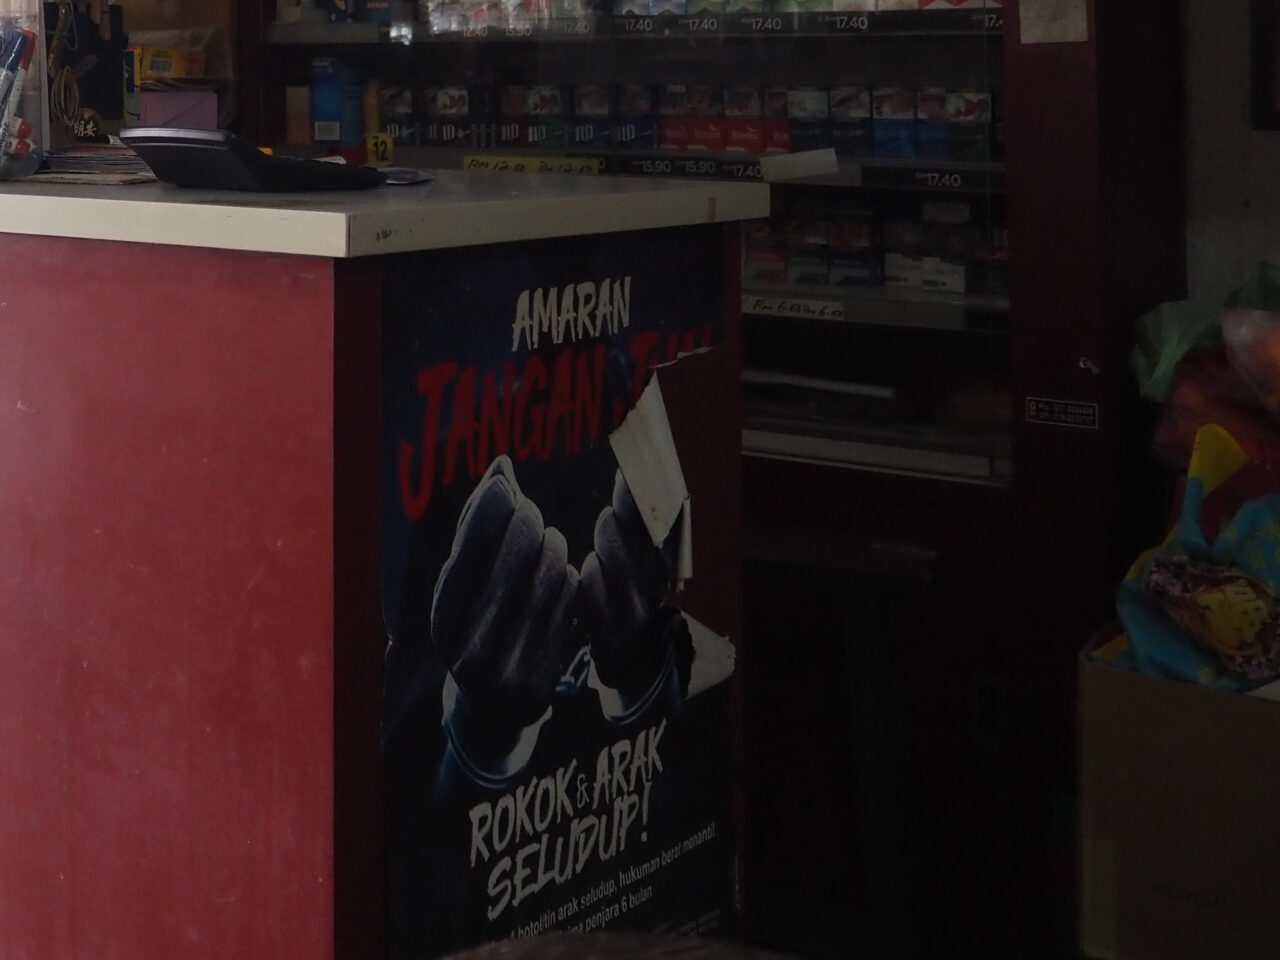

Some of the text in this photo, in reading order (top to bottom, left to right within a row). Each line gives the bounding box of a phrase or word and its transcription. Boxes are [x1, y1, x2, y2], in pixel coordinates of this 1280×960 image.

[624, 18, 654, 32] 17.40
[687, 18, 718, 31] 17.40
[751, 17, 783, 31] 17.40
[835, 15, 869, 29] 17.40
[641, 159, 673, 175] 15.90
[683, 159, 717, 175] 15.90
[926, 172, 962, 189] 17.40
[511, 275, 633, 353] AMARAN
[398, 343, 608, 523] JANGAN
[467, 716, 669, 869] ROKOK & ARAK
[486, 781, 653, 922] SELUDUP!
[558, 896, 578, 922] arak
[618, 858, 660, 890] hukuman
[660, 843, 682, 865] berat
[585, 907, 620, 934] penjara
[629, 885, 653, 910] bulan
